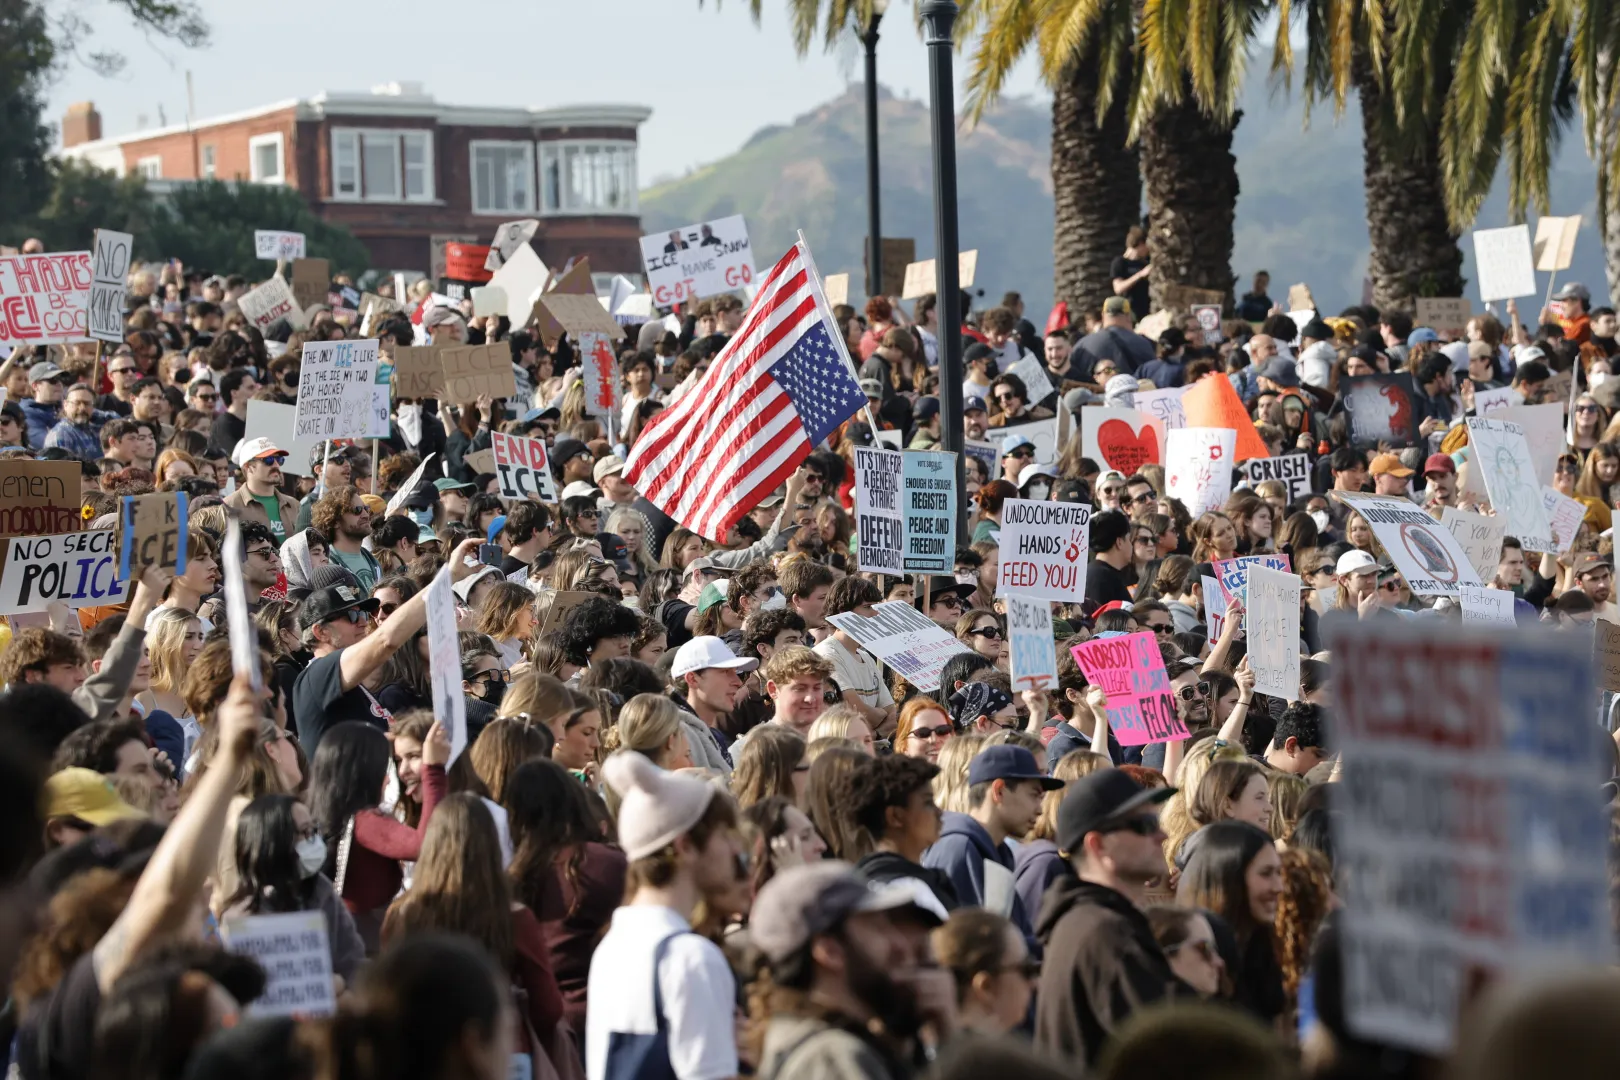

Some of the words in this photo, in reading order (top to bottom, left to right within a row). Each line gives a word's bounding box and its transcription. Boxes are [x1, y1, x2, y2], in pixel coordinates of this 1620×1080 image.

[96, 239, 127, 279] NO
[714, 238, 750, 258] SNOW
[647, 252, 678, 272] ICE
[681, 258, 717, 277] HAVE
[655, 278, 697, 303] GOT
[725, 263, 752, 287] GO
[48, 292, 77, 310] BE
[91, 287, 124, 332] KINGS
[305, 350, 316, 365] THE
[318, 349, 333, 363] ONLY
[334, 343, 353, 368] ICE
[353, 350, 358, 362] I
[359, 349, 374, 363] LIKE
[410, 348, 441, 367] FUC
[447, 345, 510, 375] ICE
[302, 373, 311, 385] IS
[315, 370, 327, 383] THE
[329, 370, 341, 381] ICE
[343, 370, 353, 382] MY
[355, 369, 368, 382] TWO
[399, 371, 440, 394] FASC
[301, 384, 315, 399] GAY
[317, 383, 345, 396] HOCKEY
[300, 397, 342, 416] BOYFRIENDS
[297, 418, 321, 436] SKATE
[324, 417, 336, 434] ON
[492, 432, 546, 470] END
[857, 449, 874, 470] IT'S
[874, 452, 889, 472] TIME
[890, 454, 902, 475] FOR
[917, 460, 926, 468] VOTE
[1250, 456, 1306, 481] CRUSH
[497, 463, 553, 500] ICE
[863, 469, 870, 489] A
[870, 470, 899, 493] GENERAL
[905, 477, 926, 489] ENOUGH
[927, 478, 933, 490] IS
[869, 488, 896, 510] STRIKE!
[911, 491, 948, 511] REGISTER
[908, 516, 934, 534] PEACE
[934, 517, 950, 535] AND
[1005, 504, 1089, 526] UNDOCUMENTED
[1361, 508, 1441, 526] DOOMERISM
[860, 514, 903, 551] DEFEND
[1447, 517, 1466, 536] IF
[1470, 523, 1490, 540] YOU
[14, 538, 52, 562] NO
[909, 537, 946, 555] FREEDOM
[1019, 533, 1061, 555] HANDS
[1002, 561, 1038, 587] FEED
[1043, 563, 1078, 593] YOU!
[1221, 561, 1232, 575] I
[1408, 579, 1440, 591] FIGHT
[1460, 589, 1501, 613] History
[836, 602, 938, 644] AMERICANS
[1011, 599, 1032, 629] SAVE
[1076, 640, 1134, 673] NOBODY
[1135, 637, 1150, 668] IS
